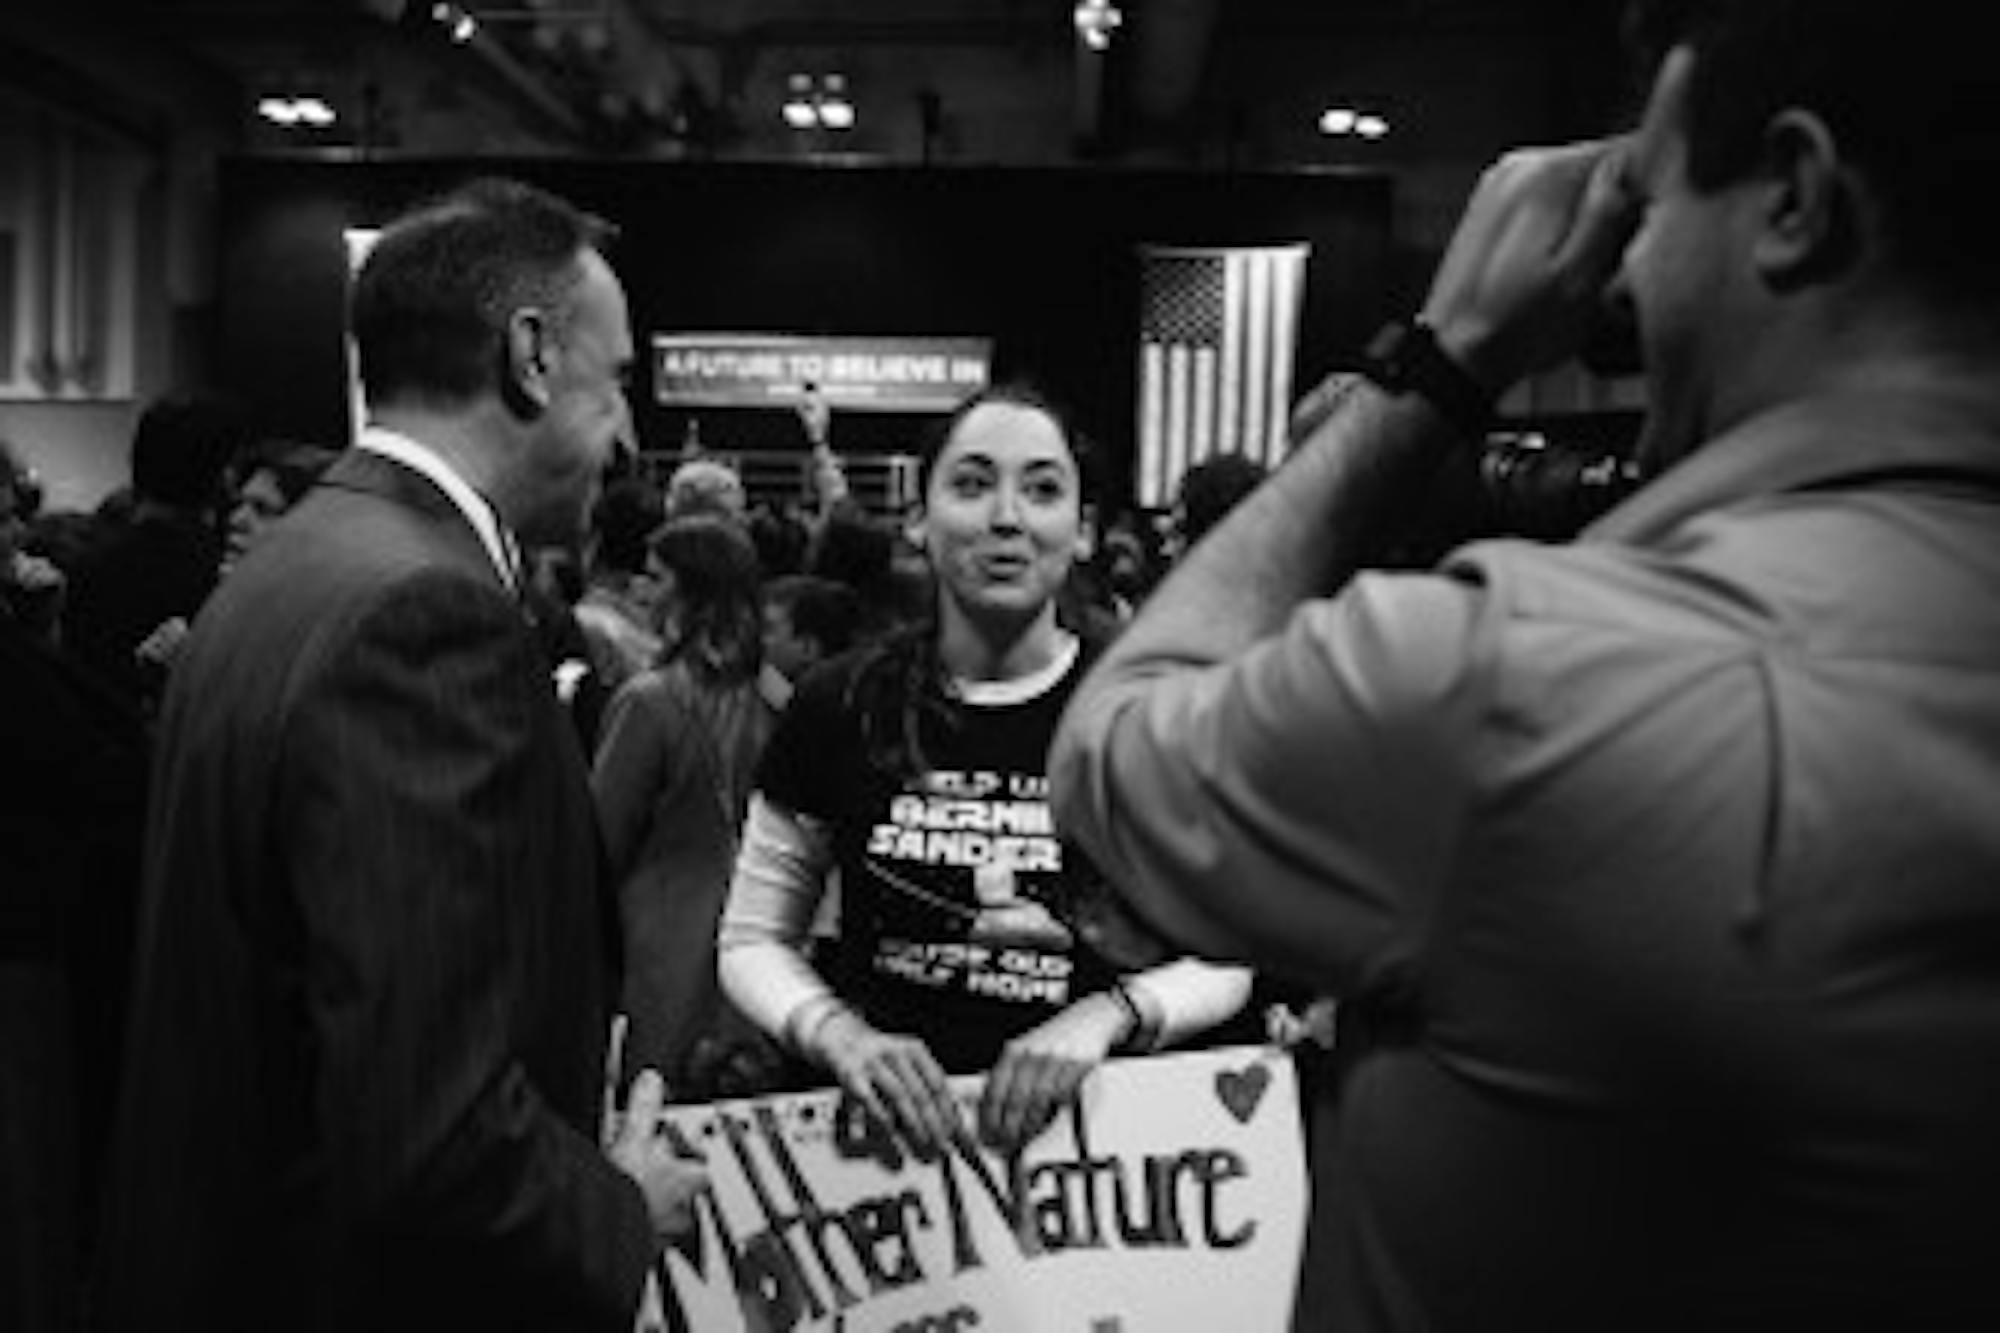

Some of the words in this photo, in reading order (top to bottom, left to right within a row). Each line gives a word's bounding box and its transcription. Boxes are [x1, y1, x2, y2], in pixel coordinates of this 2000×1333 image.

[664, 351, 682, 374] A
[684, 352, 780, 379] FUTURE
[789, 354, 823, 379] TO
[830, 355, 948, 382] BELIEVE
[951, 359, 985, 383] IN
[866, 824, 1063, 873] SANDER
[942, 1104, 1259, 1273] Nature
